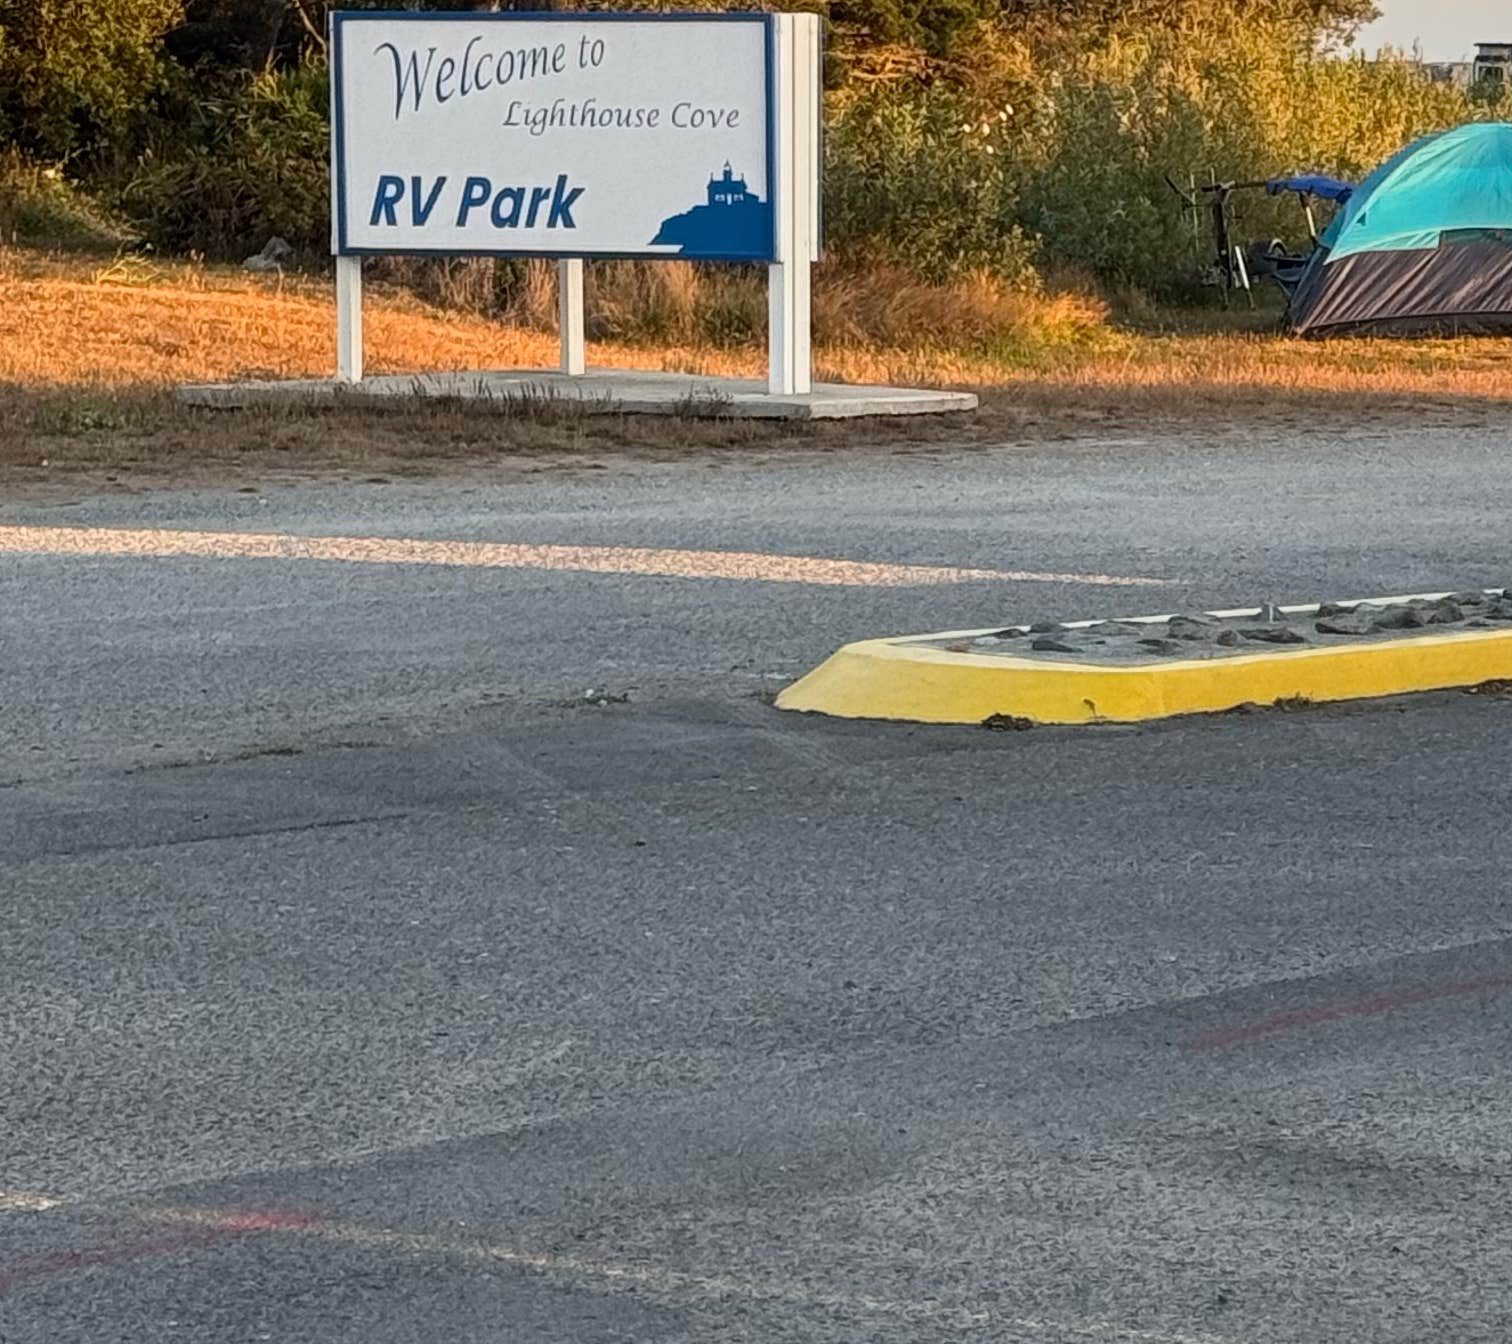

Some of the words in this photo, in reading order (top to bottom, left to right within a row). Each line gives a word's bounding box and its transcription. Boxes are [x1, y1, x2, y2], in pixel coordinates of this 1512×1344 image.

[374, 36, 566, 120] Welcome
[578, 34, 605, 68] to
[502, 98, 660, 136] Lighthouse
[671, 103, 740, 129] Cove
[370, 175, 447, 227] RV
[456, 174, 586, 229] Park
